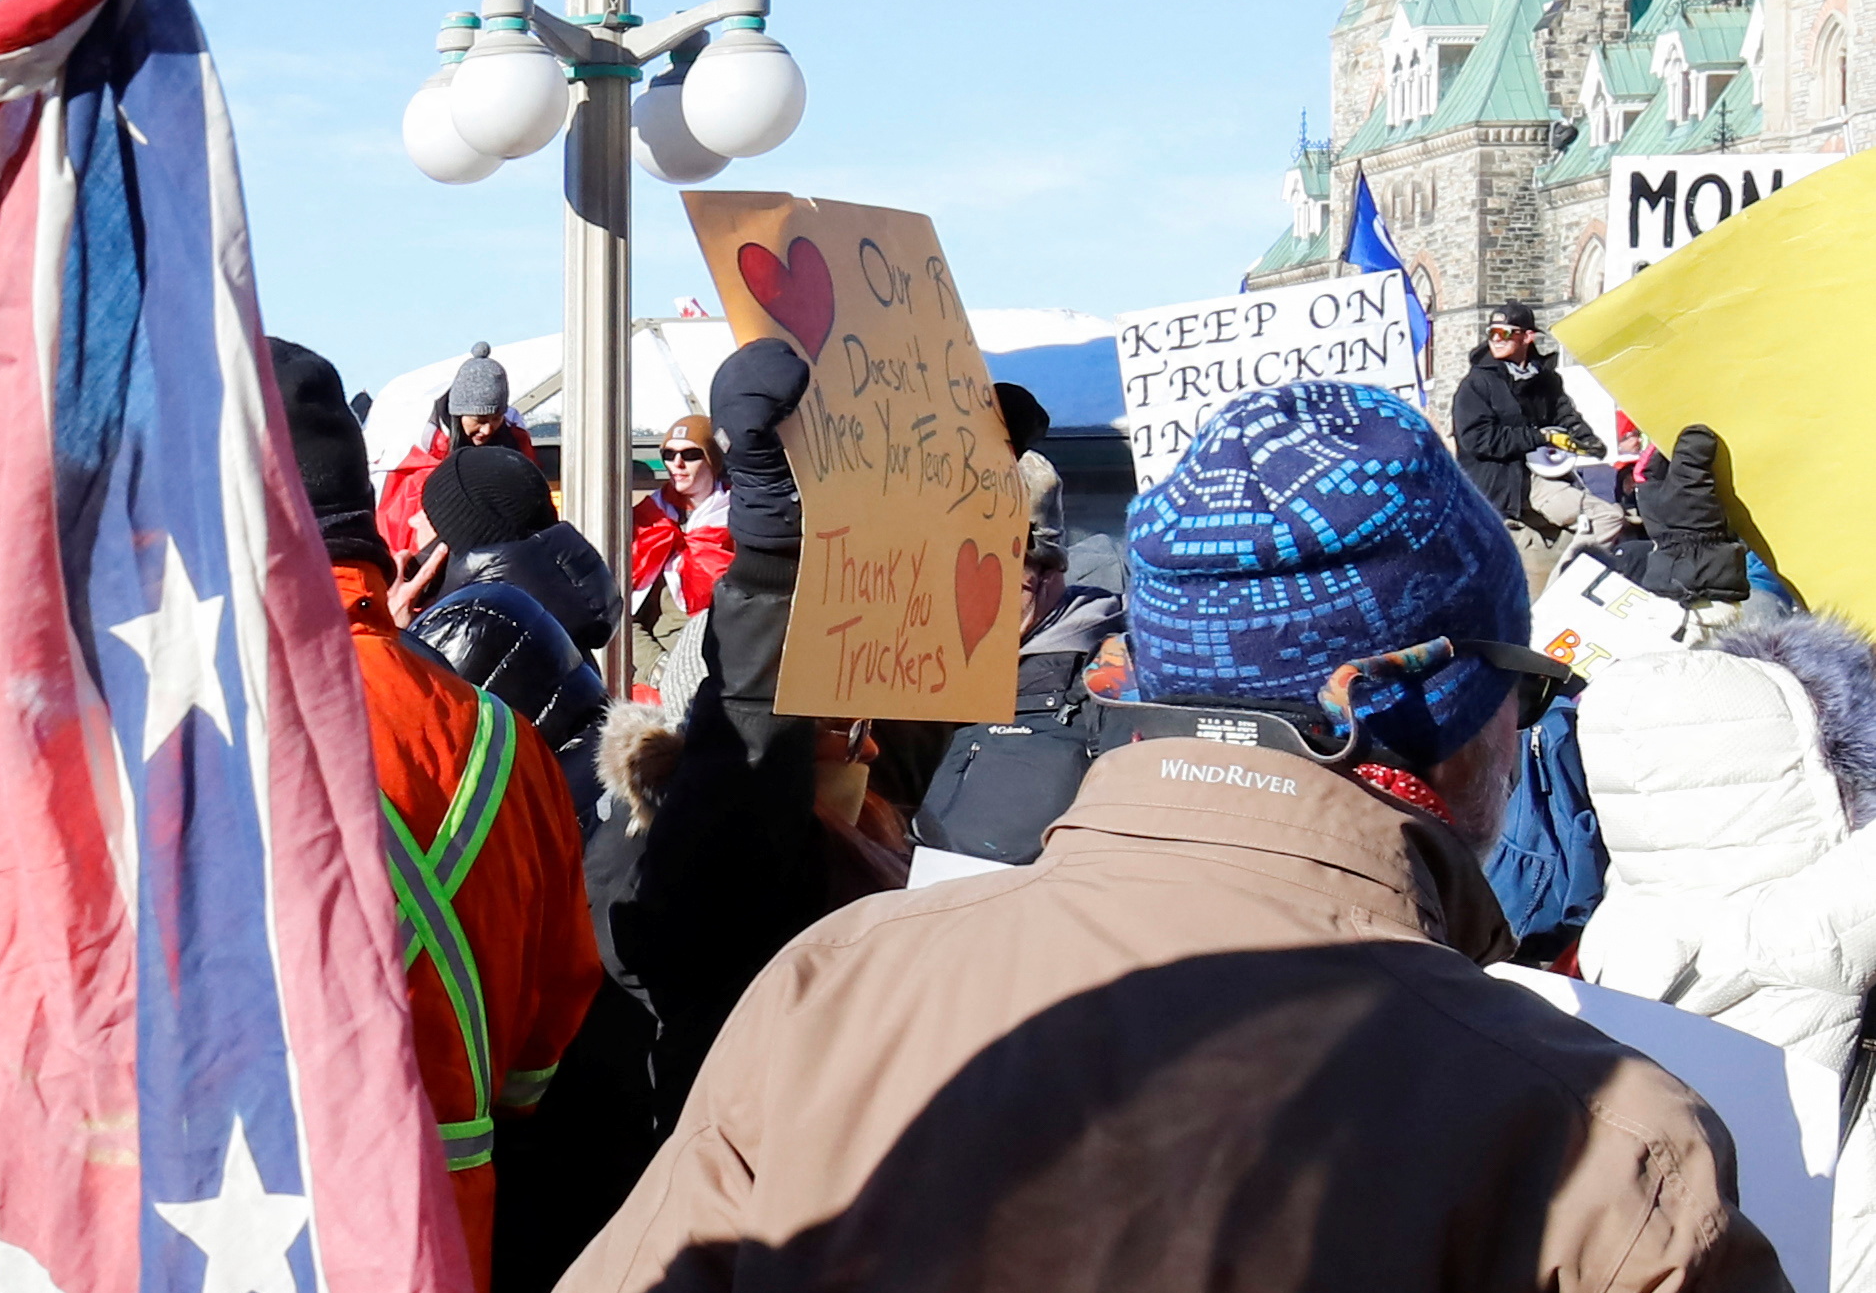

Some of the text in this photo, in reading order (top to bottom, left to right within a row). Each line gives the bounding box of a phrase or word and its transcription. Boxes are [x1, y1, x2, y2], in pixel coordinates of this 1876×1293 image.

[859, 237, 912, 314] Our
[1122, 272, 1399, 359] KEEP ON
[843, 333, 931, 403] Doesn't
[1126, 320, 1406, 408] TRUCKIN'
[797, 378, 874, 483] Where
[874, 398, 911, 496] Your
[911, 412, 952, 496] Fears
[815, 526, 933, 637] Thank You
[825, 615, 947, 701] Truckers
[1161, 758, 1298, 796] WINDRIVER
